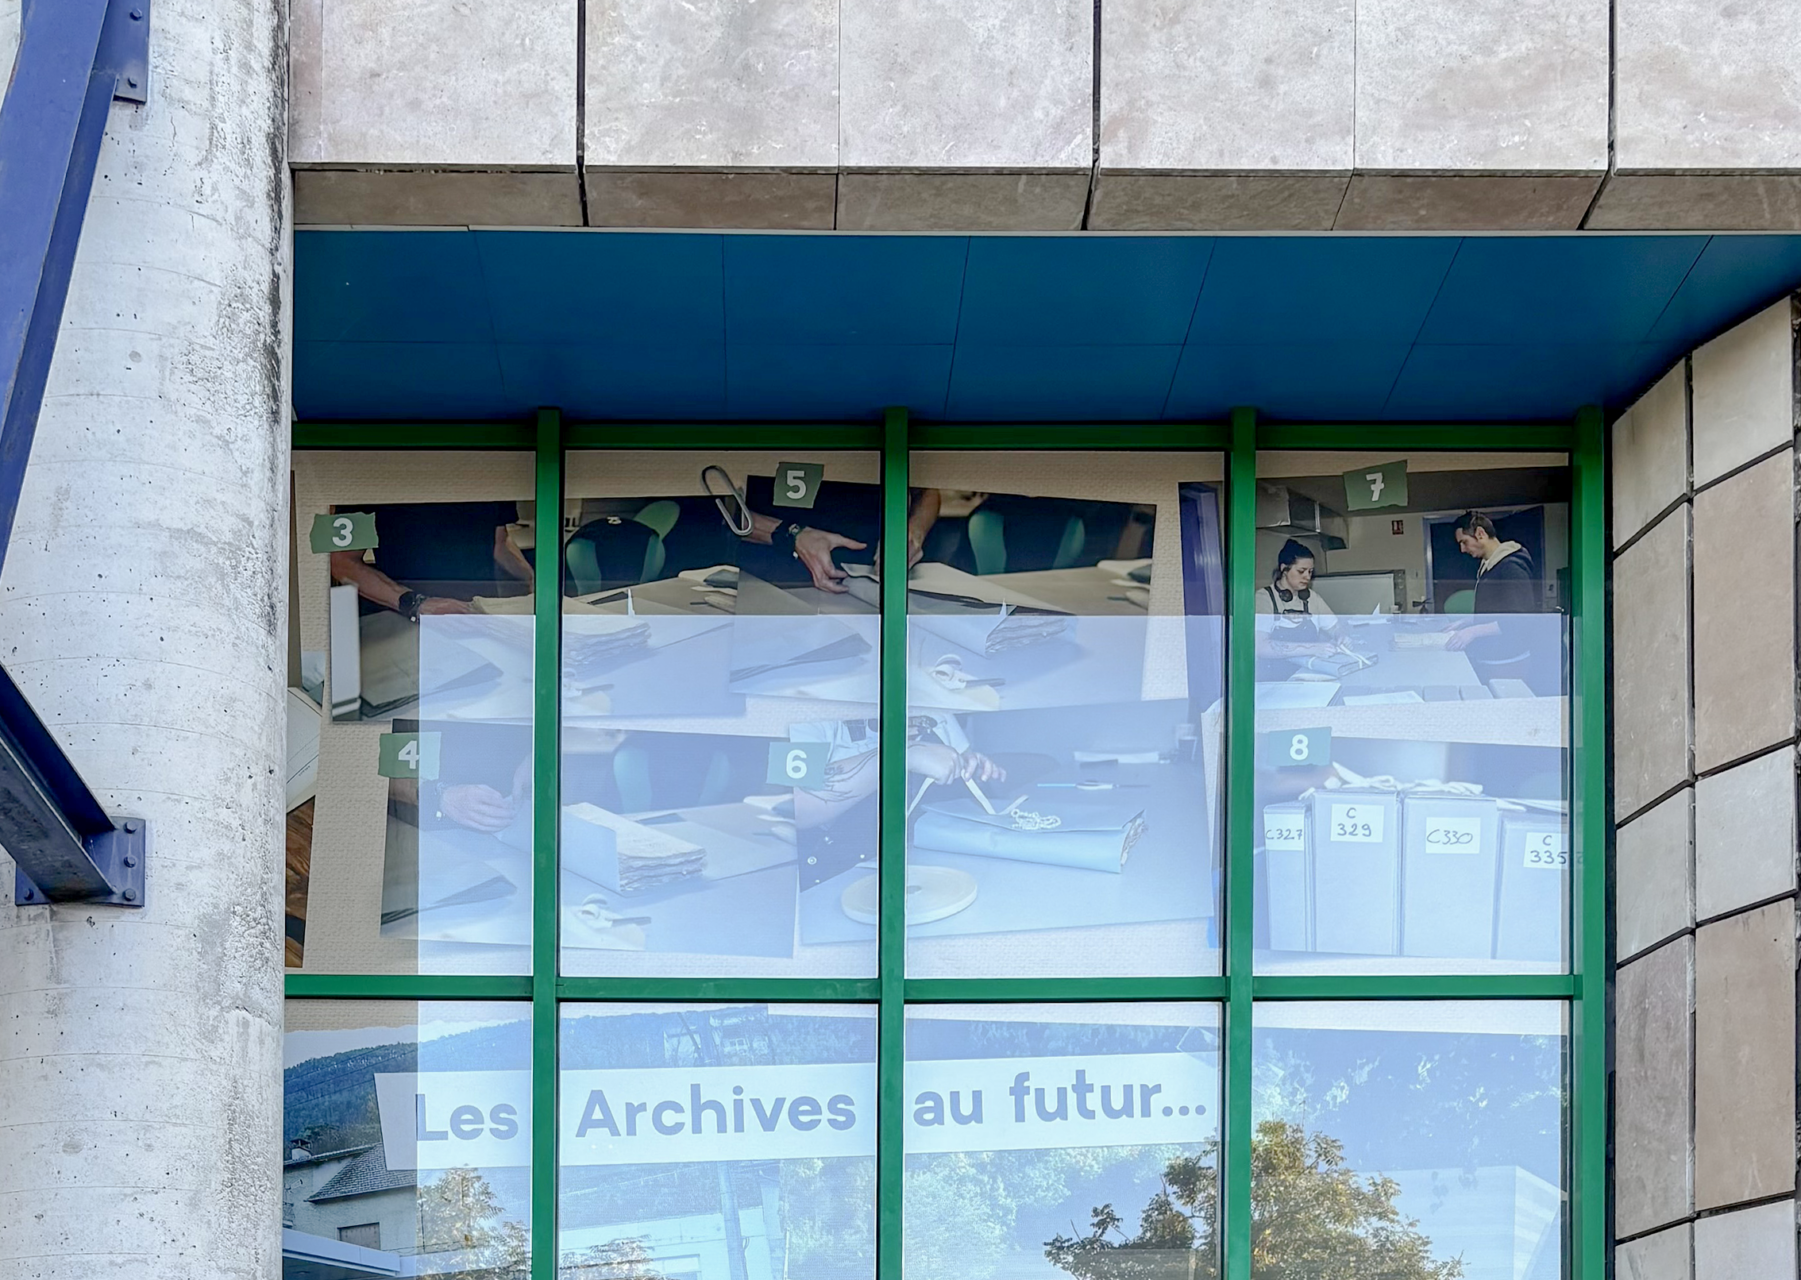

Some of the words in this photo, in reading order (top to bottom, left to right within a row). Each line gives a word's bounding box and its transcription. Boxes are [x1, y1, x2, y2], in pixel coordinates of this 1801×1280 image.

[785, 470, 807, 500] 5
[1365, 471, 1385, 502] 7
[331, 516, 354, 547] 3
[397, 740, 420, 770] 4
[1289, 734, 1310, 761] 8
[785, 749, 808, 780] 6
[1346, 807, 1357, 819] C
[1336, 823, 1372, 837] 329
[1426, 828, 1474, 846] C330
[1542, 834, 1553, 846] C
[415, 1093, 519, 1141] Les
[575, 1083, 857, 1138] Archives
[912, 1090, 984, 1127] au
[1008, 1068, 1207, 1123] futur...
